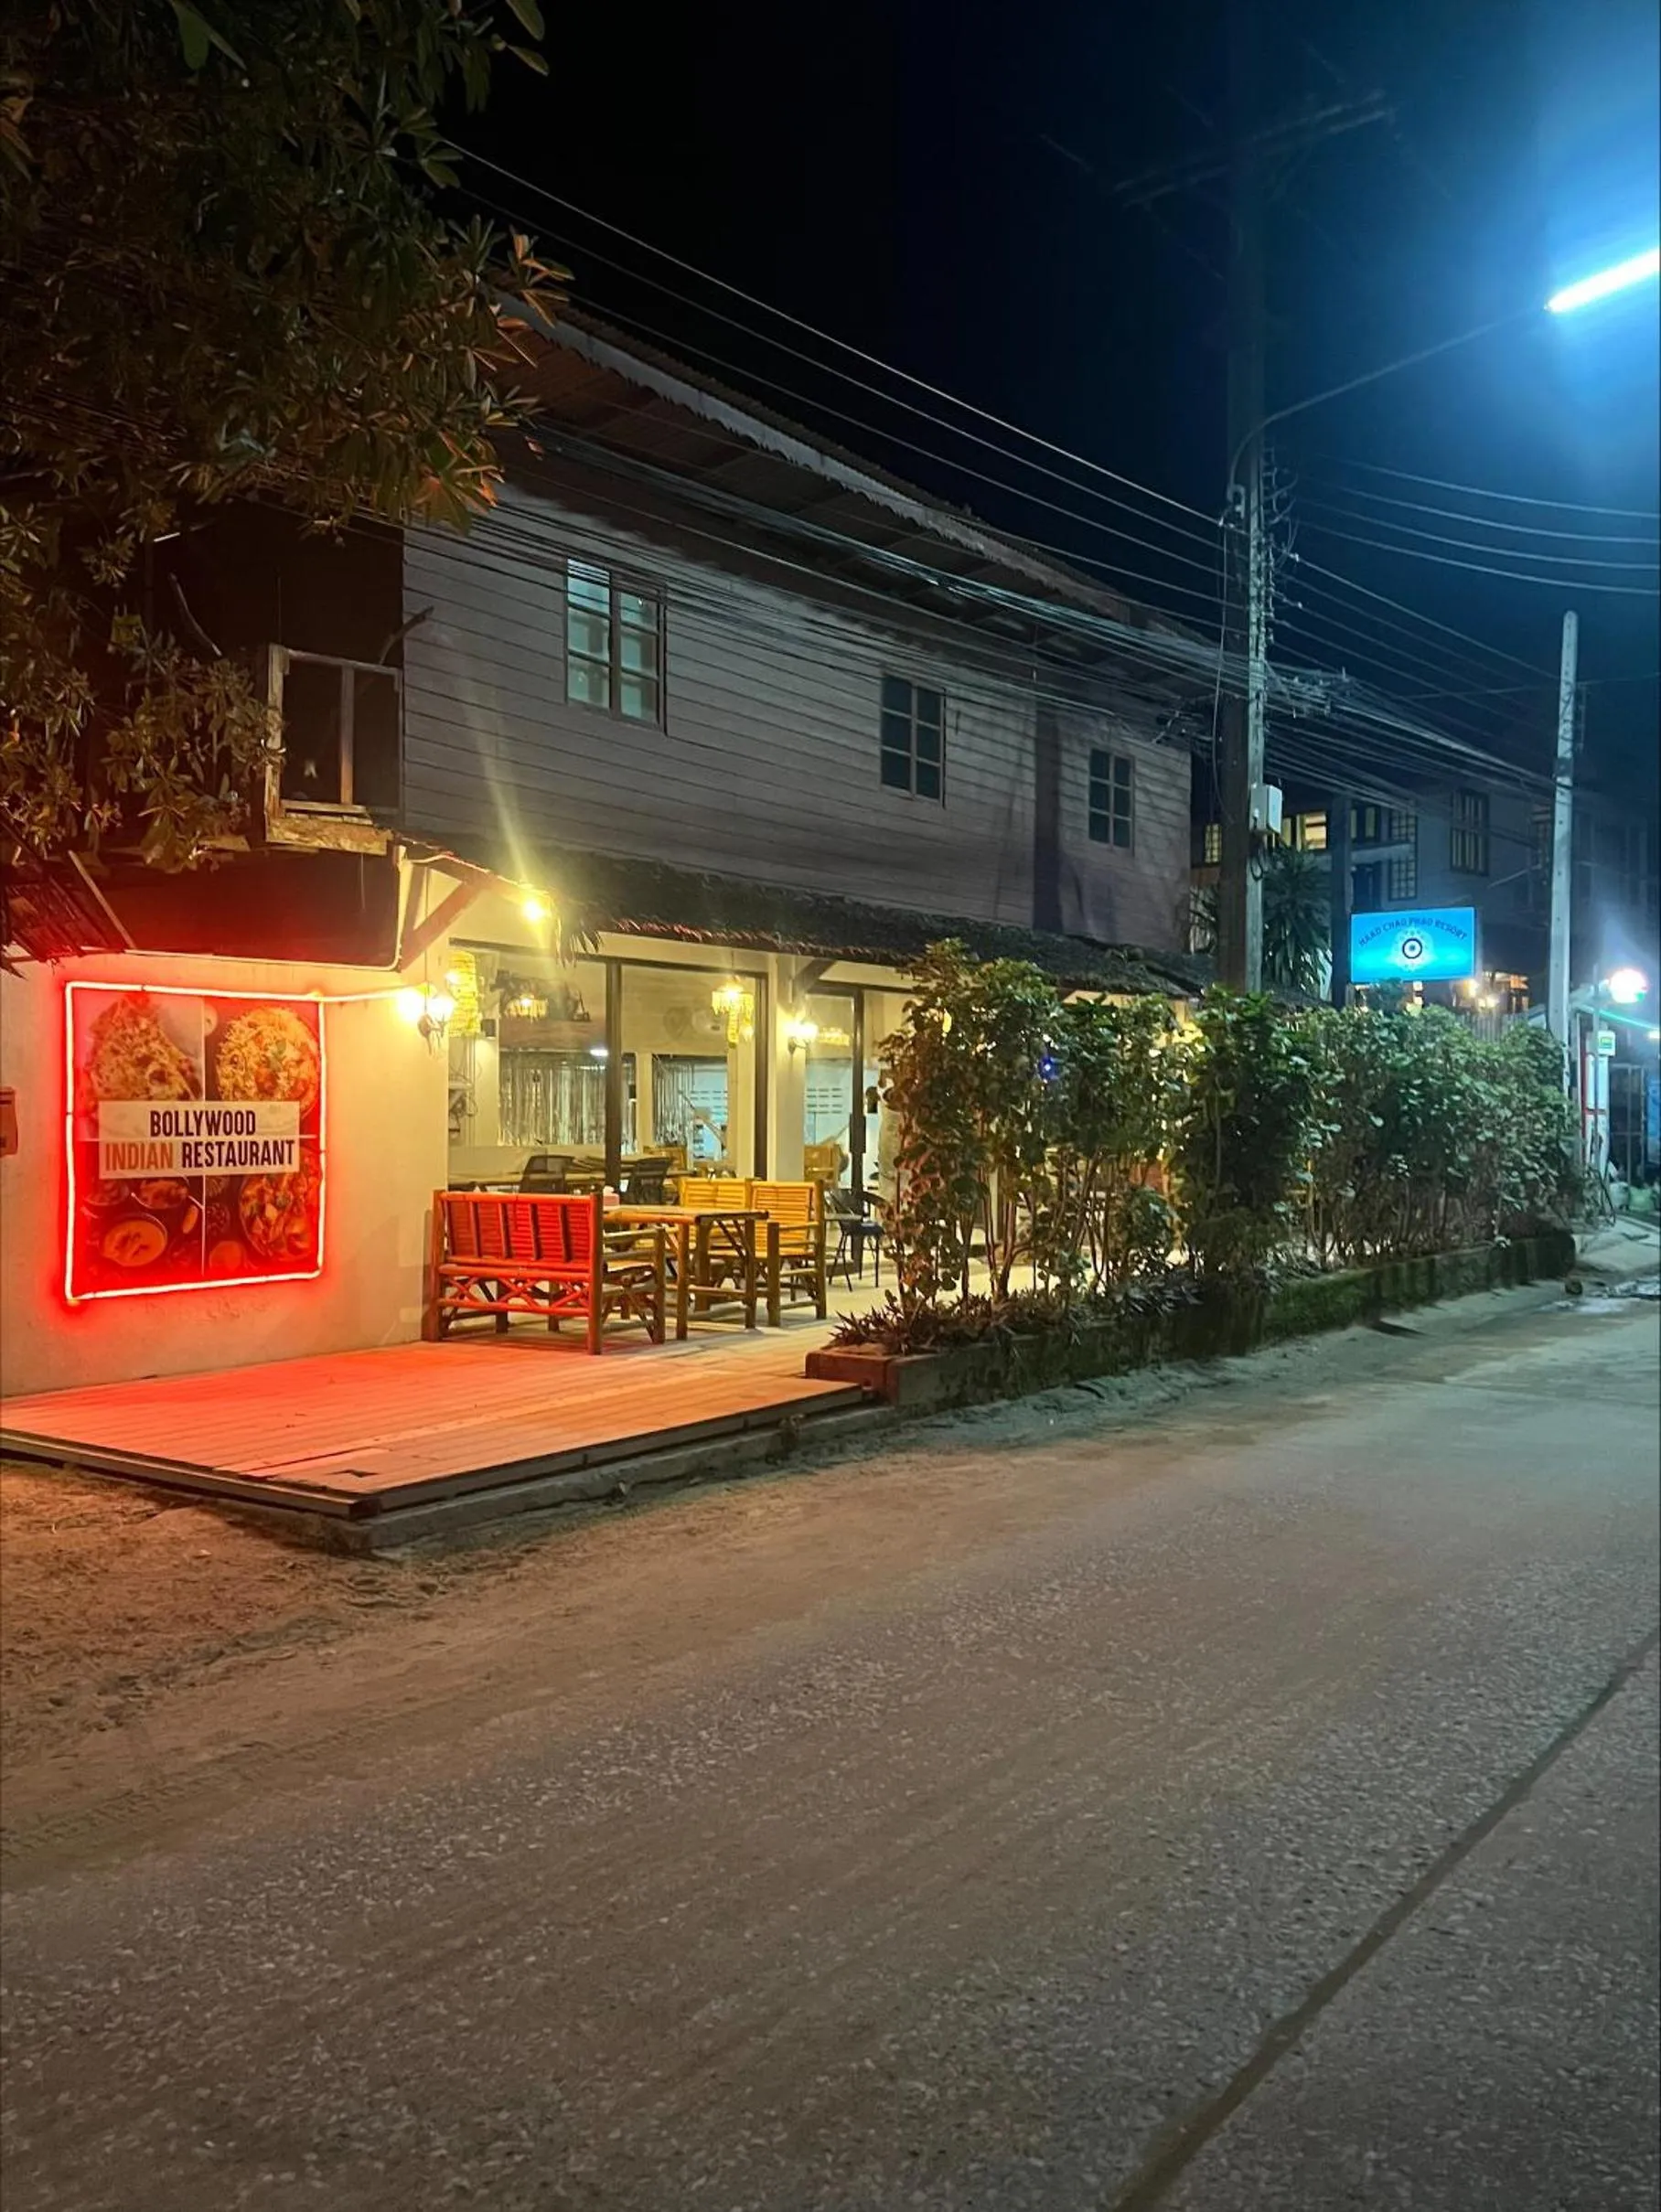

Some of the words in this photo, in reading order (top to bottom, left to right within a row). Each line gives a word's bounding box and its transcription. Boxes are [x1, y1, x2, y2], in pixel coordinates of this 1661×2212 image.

[1434, 919, 1468, 941] RESORT
[150, 1109, 256, 1138] BOLLYWOOD
[105, 1142, 174, 1171] INDIAN
[181, 1139, 295, 1169] RESTAURANT
